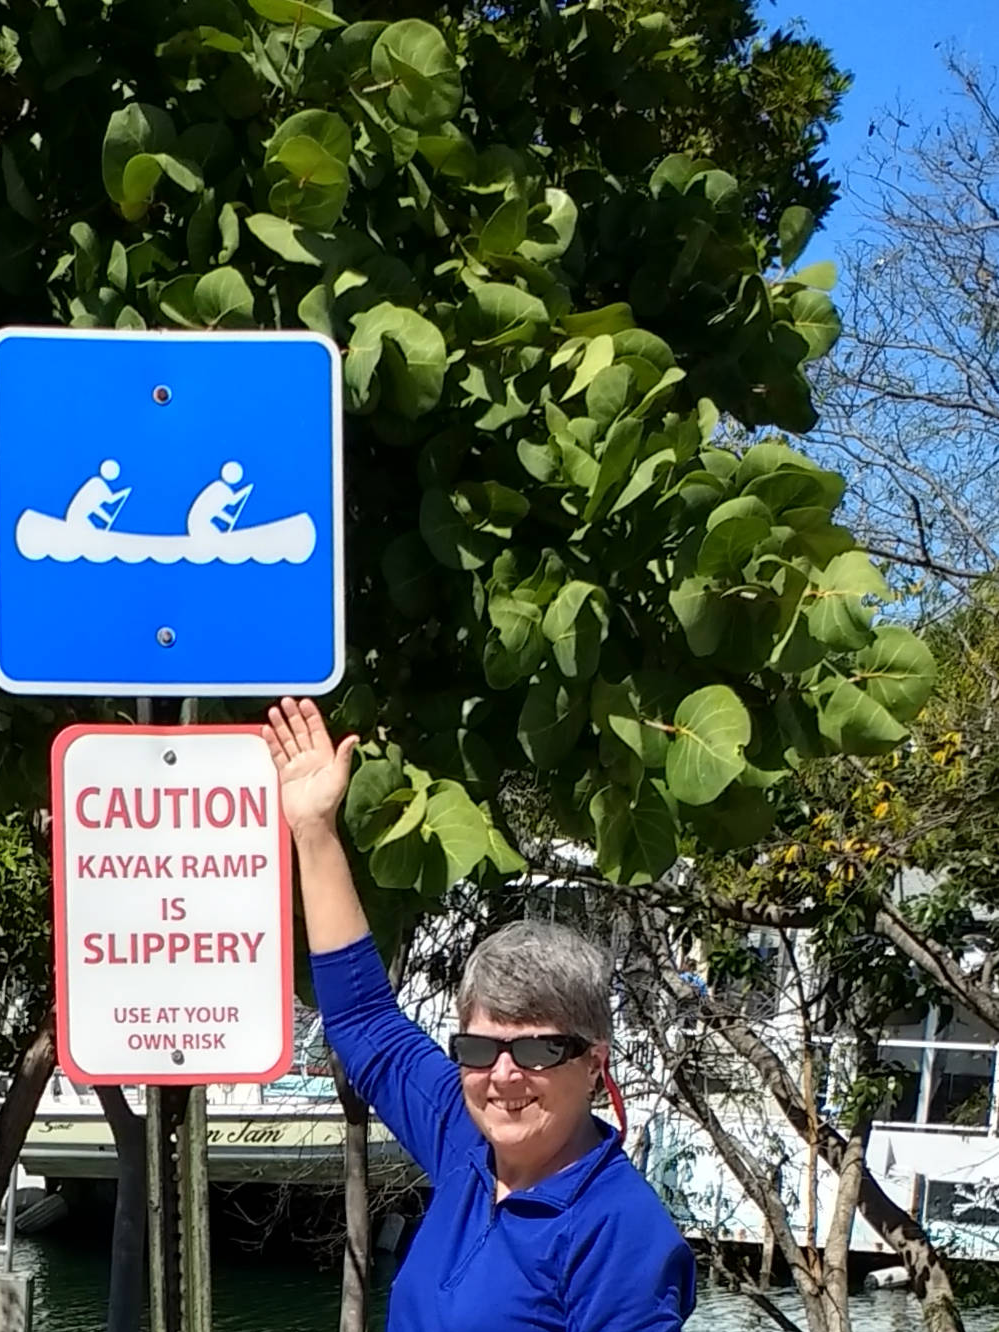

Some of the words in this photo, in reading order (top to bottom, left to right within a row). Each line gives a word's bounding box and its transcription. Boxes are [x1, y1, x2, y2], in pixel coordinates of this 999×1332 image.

[75, 786, 268, 829] CAUTION
[77, 855, 174, 879] KAYAK
[181, 854, 268, 878] RAMP
[161, 897, 186, 921] IS
[83, 932, 266, 965] SLIPPERY
[113, 1007, 151, 1024] USE
[156, 1007, 181, 1023] AT
[184, 1006, 240, 1023] YOUR
[127, 1034, 177, 1050] OWN
[182, 1033, 226, 1049] RISK
[227, 1119, 282, 1143] Jam
